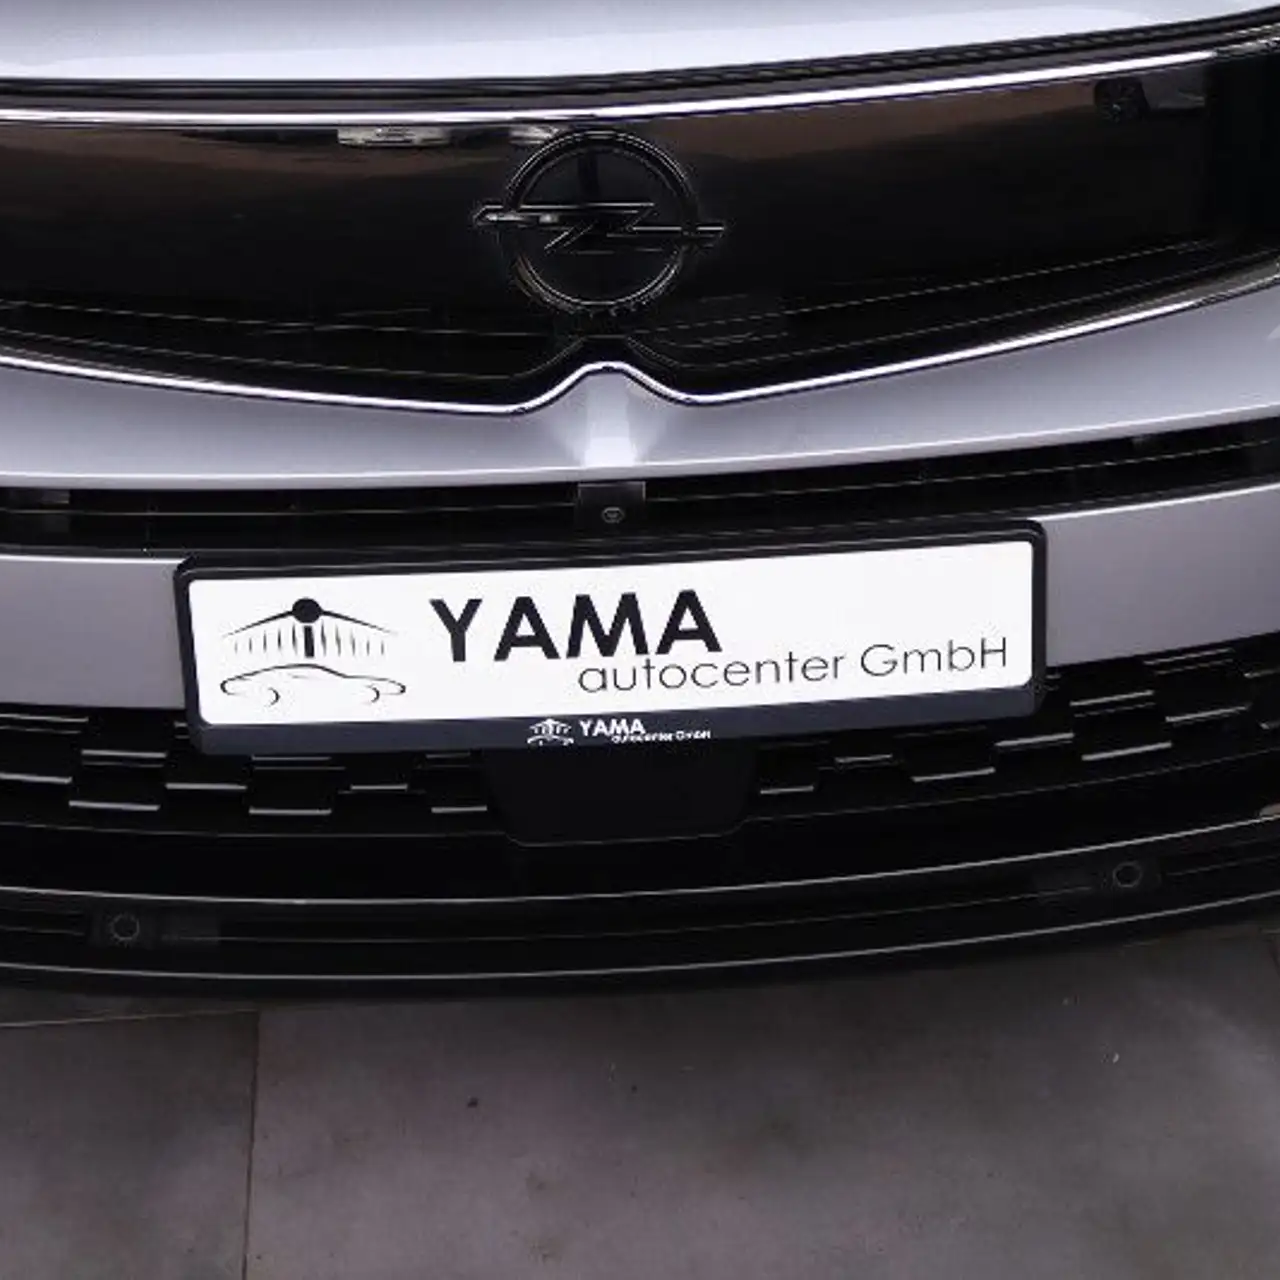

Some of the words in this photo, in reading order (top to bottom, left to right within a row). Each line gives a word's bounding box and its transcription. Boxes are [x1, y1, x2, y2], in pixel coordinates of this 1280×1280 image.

[429, 588, 723, 663] YAMA
[577, 650, 845, 694] autocenter
[859, 635, 1010, 679] GmbH
[579, 718, 646, 738] YAMA
